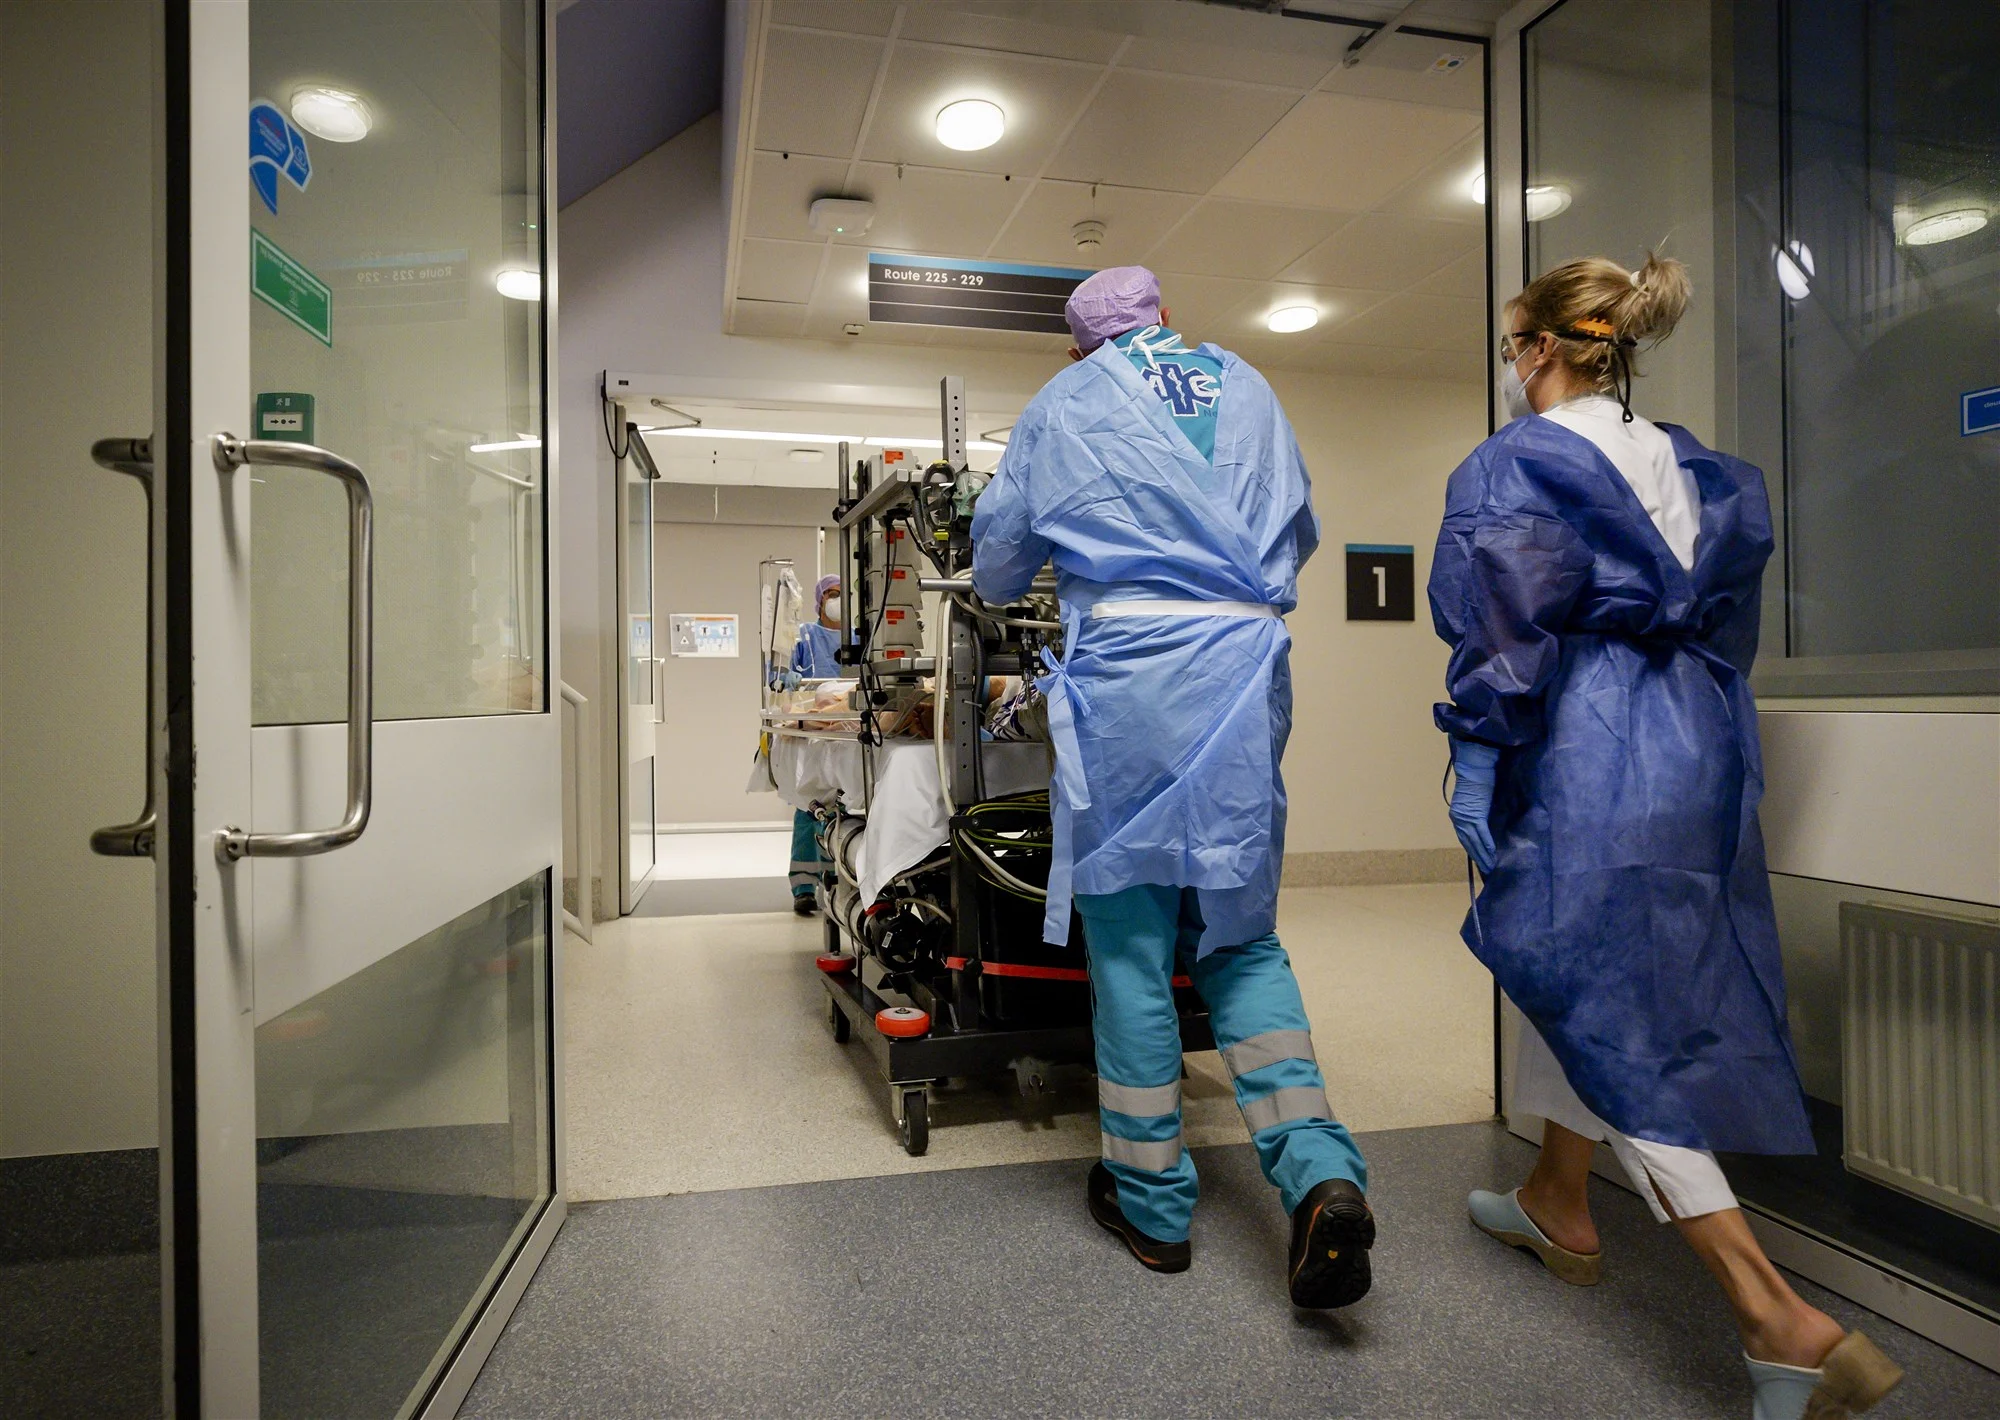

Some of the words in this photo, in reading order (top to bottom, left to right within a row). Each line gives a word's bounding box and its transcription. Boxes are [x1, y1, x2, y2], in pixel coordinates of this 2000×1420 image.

[884, 268, 921, 281] Route
[925, 271, 948, 283] 225
[960, 274, 984, 286] 229
[1372, 566, 1386, 607] 1
